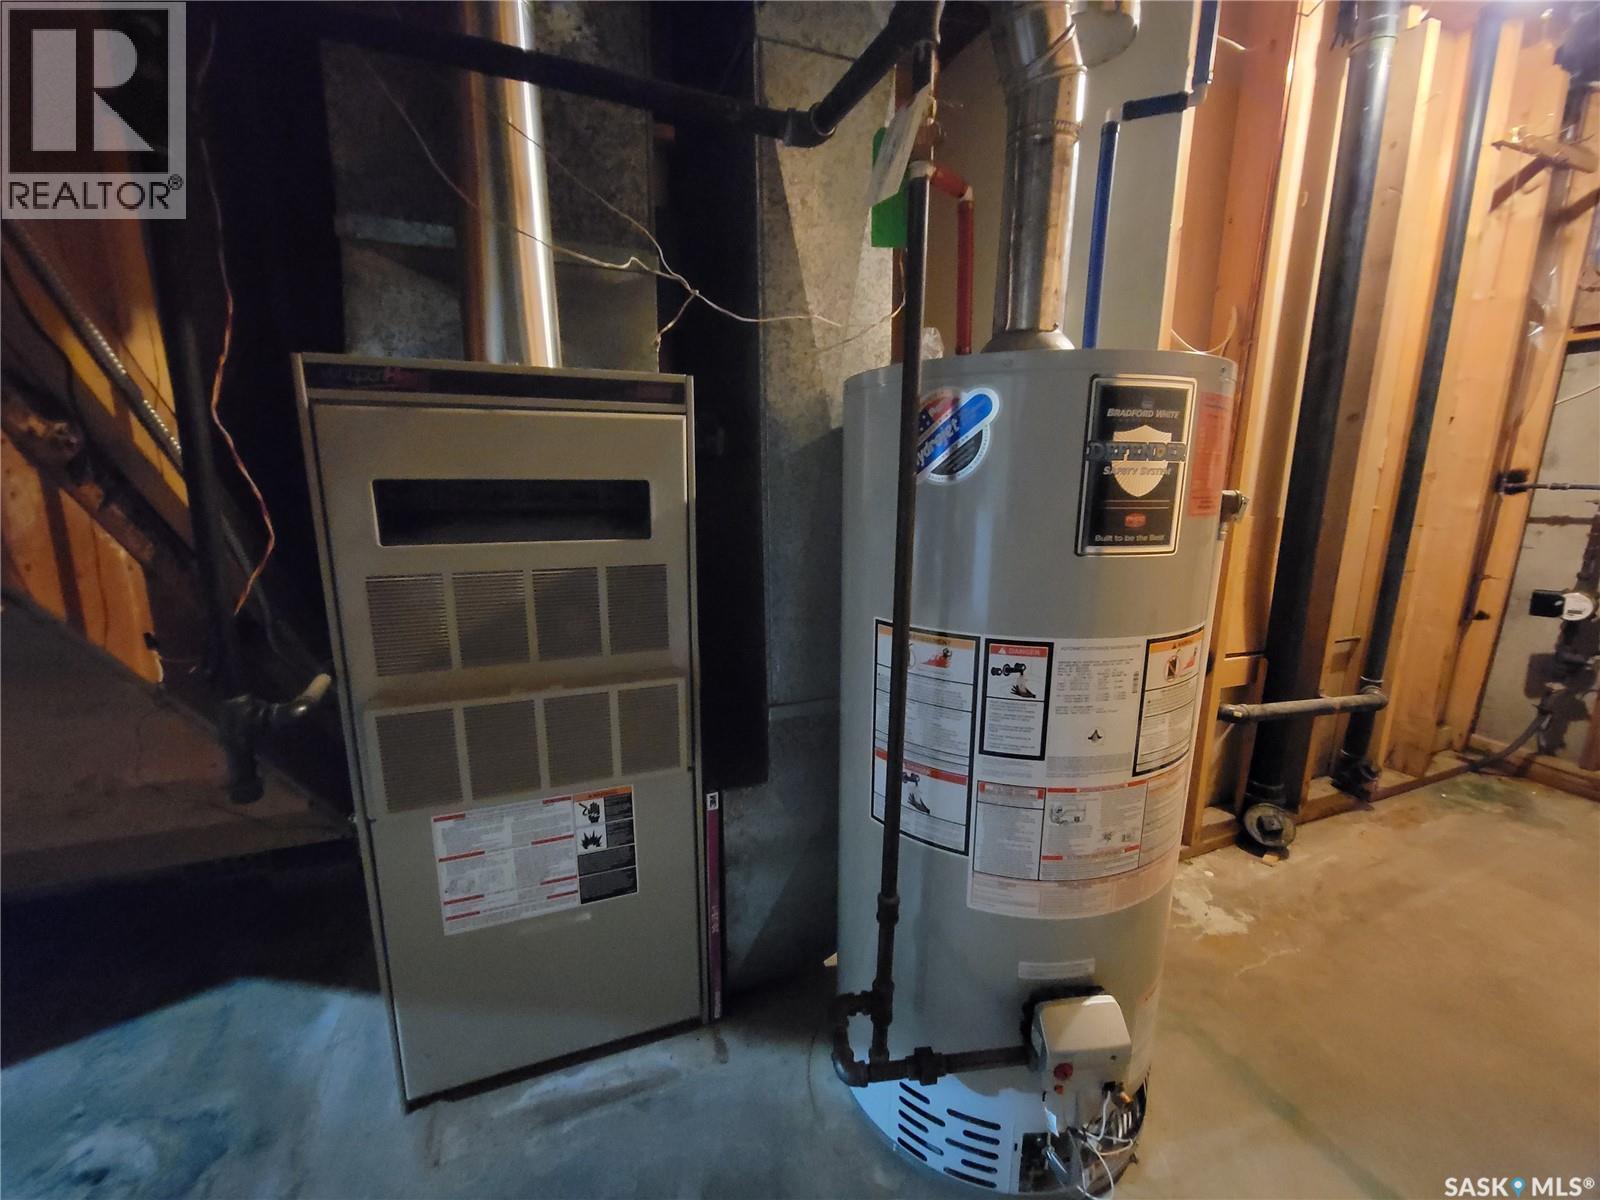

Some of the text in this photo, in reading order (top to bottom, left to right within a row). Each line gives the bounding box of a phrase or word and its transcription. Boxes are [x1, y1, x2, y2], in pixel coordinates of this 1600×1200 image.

[1106, 408, 1180, 419] BRADFORD WHITE
[1086, 441, 1186, 462] DEFENDER
[1094, 534, 1113, 542] Built
[1114, 534, 1124, 542] to
[1124, 534, 1136, 542] be
